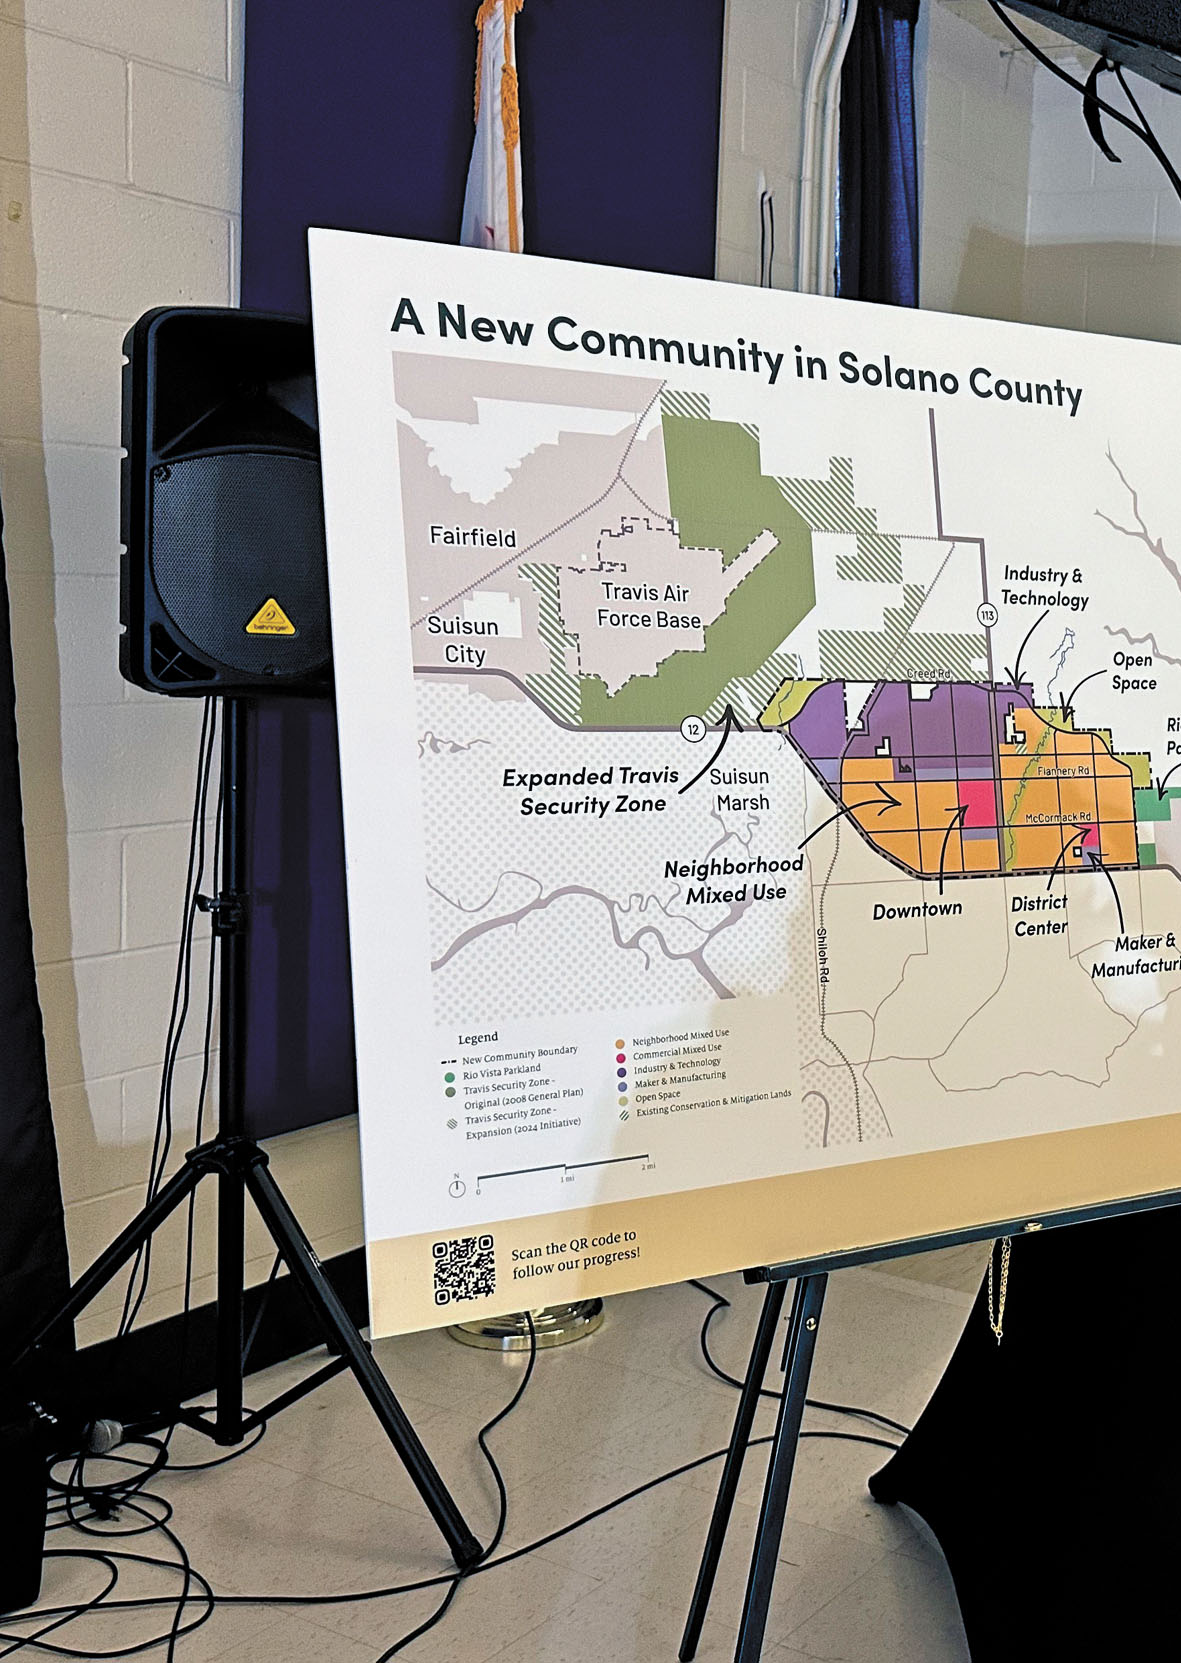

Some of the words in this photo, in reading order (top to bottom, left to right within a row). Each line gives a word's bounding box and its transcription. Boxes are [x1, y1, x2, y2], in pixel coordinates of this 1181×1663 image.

[390, 297, 424, 335] A
[437, 304, 534, 346] New
[547, 315, 782, 384] Community
[794, 345, 827, 381] in
[839, 350, 959, 395] Solano
[969, 367, 1083, 417] County
[430, 525, 517, 548] Fairfield
[1004, 565, 1068, 587] Industry
[1071, 568, 1083, 583] &
[602, 582, 658, 602] Travis
[664, 584, 689, 602] Air
[1001, 589, 1089, 612] Technology
[597, 610, 653, 628] Force
[657, 611, 702, 629] Base
[981, 610, 994, 621] 113
[428, 616, 498, 637] Suisun
[445, 645, 486, 667] City
[1113, 652, 1153, 671] Open
[907, 669, 935, 678] Creed
[938, 669, 950, 678] Rd
[1112, 675, 1157, 694] Space
[688, 724, 699, 736] 12
[503, 767, 613, 791] Expanded
[619, 765, 680, 785] Travis
[710, 768, 770, 785] Suisun
[1038, 766, 1076, 777] Flannery
[1079, 766, 1089, 775] Rd
[520, 797, 610, 818] Security
[615, 795, 667, 814] Zone
[717, 795, 770, 812] Marsh
[1026, 812, 1077, 823] McCormack
[1079, 812, 1091, 821] Rd
[664, 854, 804, 882] Neighborhood
[686, 886, 747, 905] Mixed
[752, 885, 787, 901] Use
[1011, 894, 1068, 913] District
[873, 901, 963, 920] Downtown
[1014, 921, 1068, 938] Center
[817, 928, 828, 964] Shiloh
[1115, 935, 1162, 952] Maker
[1165, 932, 1176, 947] &
[820, 968, 830, 983] Rd
[458, 1031, 498, 1046] Legend
[632, 1033, 689, 1047] Neighborhood
[690, 1030, 714, 1040] Mixed
[716, 1029, 729, 1038] Use
[462, 1056, 483, 1066] New
[484, 1049, 535, 1063] Community
[538, 1046, 578, 1057] Boundary
[633, 1049, 680, 1060] Commercial
[682, 1044, 706, 1055] Mixed
[708, 1043, 722, 1052] Use
[463, 1071, 478, 1080] Rio
[480, 1068, 502, 1078] Vista
[504, 1063, 541, 1075] Parkland
[634, 1064, 667, 1075] Industry
[677, 1057, 721, 1070] Technology
[464, 1085, 490, 1095] Travis
[492, 1081, 526, 1093] Security
[529, 1078, 550, 1087] Zone
[635, 1078, 659, 1088] Maker
[661, 1077, 667, 1085] &
[669, 1070, 726, 1084] Manufacturing
[465, 1098, 500, 1110] Original
[502, 1095, 526, 1106] (2008
[528, 1091, 560, 1102] General
[563, 1088, 584, 1098] Plan)
[635, 1093, 656, 1105] Open
[658, 1090, 681, 1101] Space
[636, 1105, 669, 1117] Existing
[670, 1099, 721, 1112] Conservation
[722, 1098, 728, 1106] &
[730, 1092, 769, 1105] Mitigation
[770, 1089, 792, 1099] Lands
[465, 1116, 491, 1125] Travis
[493, 1110, 528, 1122] Security
[530, 1107, 552, 1117] Zone
[466, 1127, 512, 1140] Expansion
[514, 1124, 538, 1134] (2024
[540, 1117, 581, 1130] Initiative)
[647, 1162, 656, 1170] mi
[512, 1247, 542, 1261] Scan
[546, 1242, 567, 1255] the
[570, 1238, 589, 1253] QR
[591, 1233, 621, 1248] code
[624, 1231, 637, 1242] to
[513, 1261, 555, 1280] follow
[557, 1258, 580, 1272] our
[583, 1246, 641, 1270] progress!
